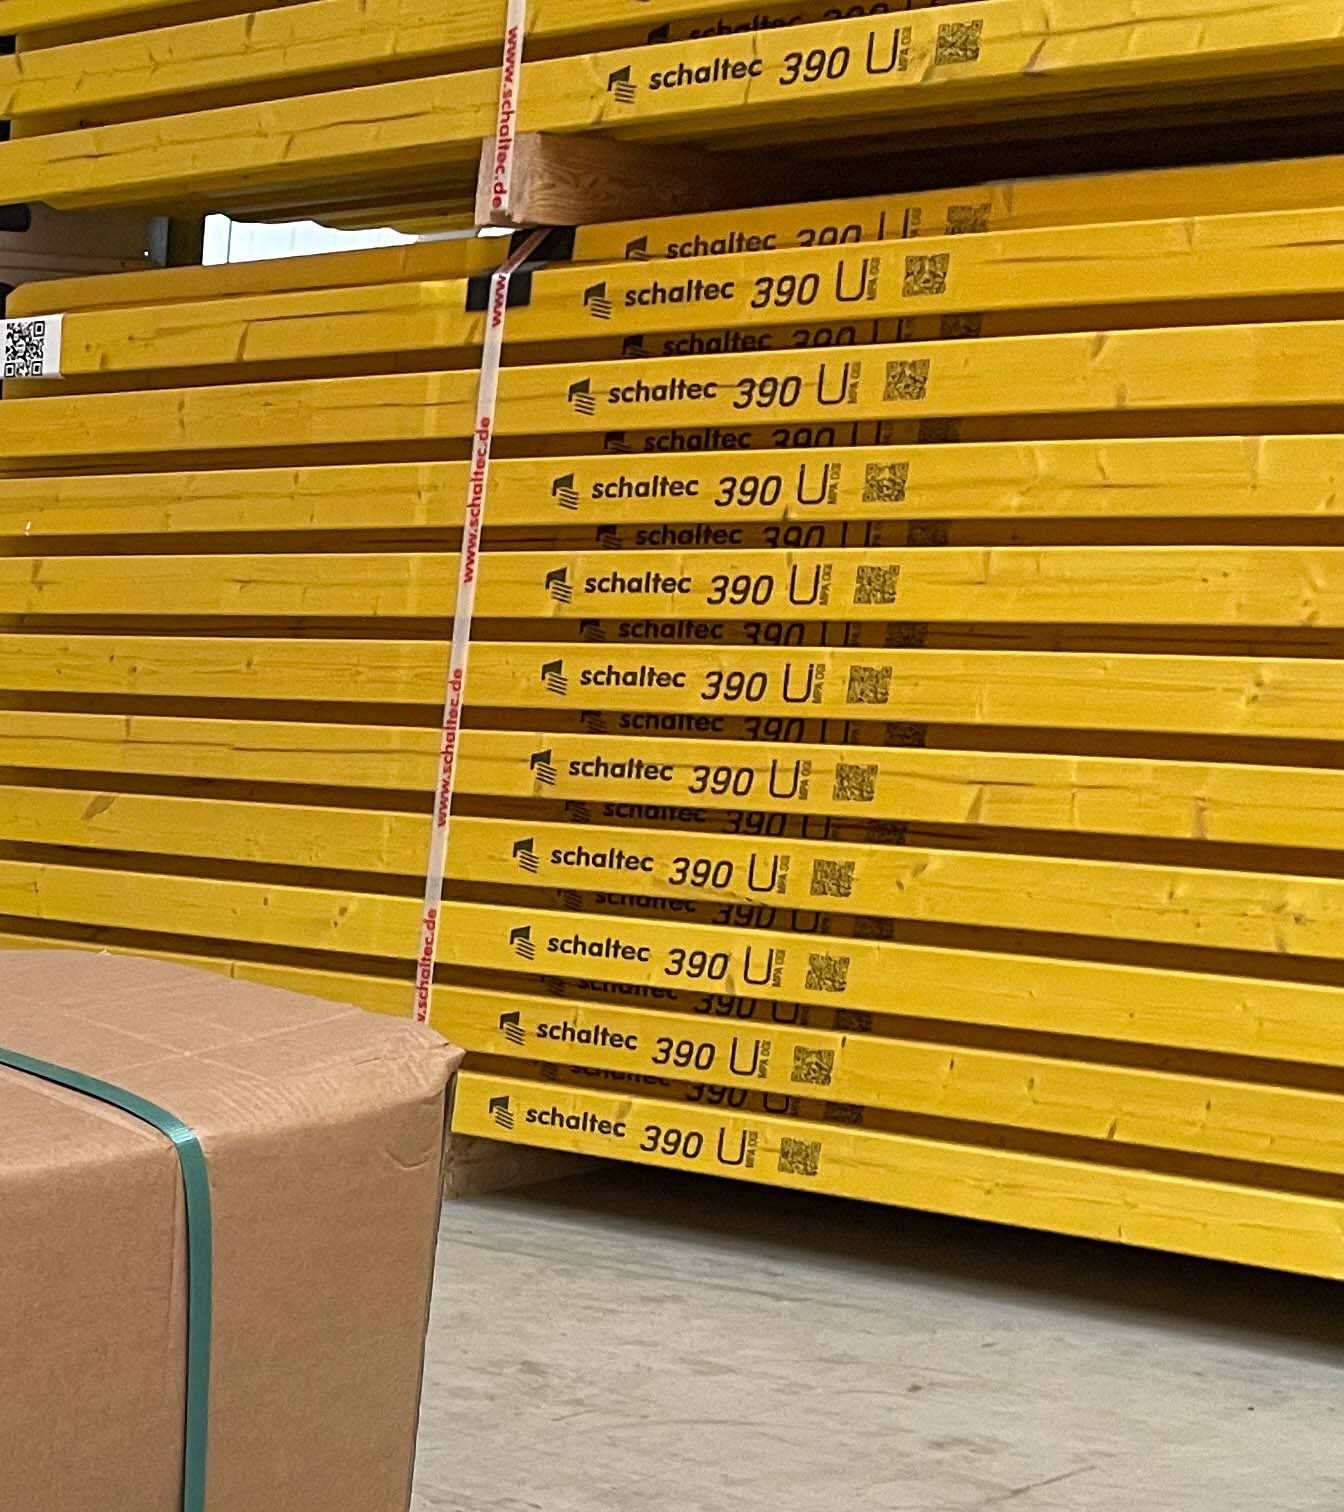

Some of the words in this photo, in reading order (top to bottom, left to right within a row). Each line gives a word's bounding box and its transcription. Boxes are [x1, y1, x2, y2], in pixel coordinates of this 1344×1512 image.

[648, 58, 763, 89] schaltec
[779, 46, 850, 85] 390
[866, 28, 900, 74] U
[493, 26, 518, 208] www.schaltec.de
[667, 231, 776, 259] schaltec
[625, 280, 734, 307] schaltec
[750, 273, 819, 308] 390
[836, 258, 869, 301] U
[662, 330, 772, 355] schaltec
[608, 378, 717, 403] schaltec
[733, 375, 801, 409] 390
[817, 362, 849, 404] U
[643, 429, 751, 451] schaltec
[464, 416, 490, 583] www.schaltec.de
[592, 477, 699, 499] schaltec
[714, 475, 782, 507] 390
[797, 464, 830, 505] U
[636, 524, 743, 546] schaltec
[585, 572, 691, 593] schaltec
[707, 575, 774, 605] 390
[789, 564, 821, 605] U
[619, 620, 723, 639] schaltec
[580, 666, 685, 688] schaltec
[701, 670, 767, 701] 390
[783, 663, 813, 703] U
[620, 711, 724, 731] schaltec
[437, 668, 462, 827] www.schaltec.de
[569, 756, 673, 780] schaltec
[688, 766, 754, 795] 390
[769, 760, 800, 798] U
[723, 811, 785, 835] 390
[551, 846, 654, 871] schaltec
[668, 857, 732, 888] 390
[748, 853, 779, 891] U
[712, 906, 776, 929] 390
[547, 935, 650, 962] schaltec
[664, 949, 728, 980] 390
[744, 946, 773, 984] U
[537, 1021, 637, 1050] schaltec
[652, 1037, 715, 1069] 390
[730, 1038, 760, 1076] U
[525, 1107, 626, 1137] schaltec
[640, 1125, 703, 1158] 390
[717, 1127, 747, 1165] U
